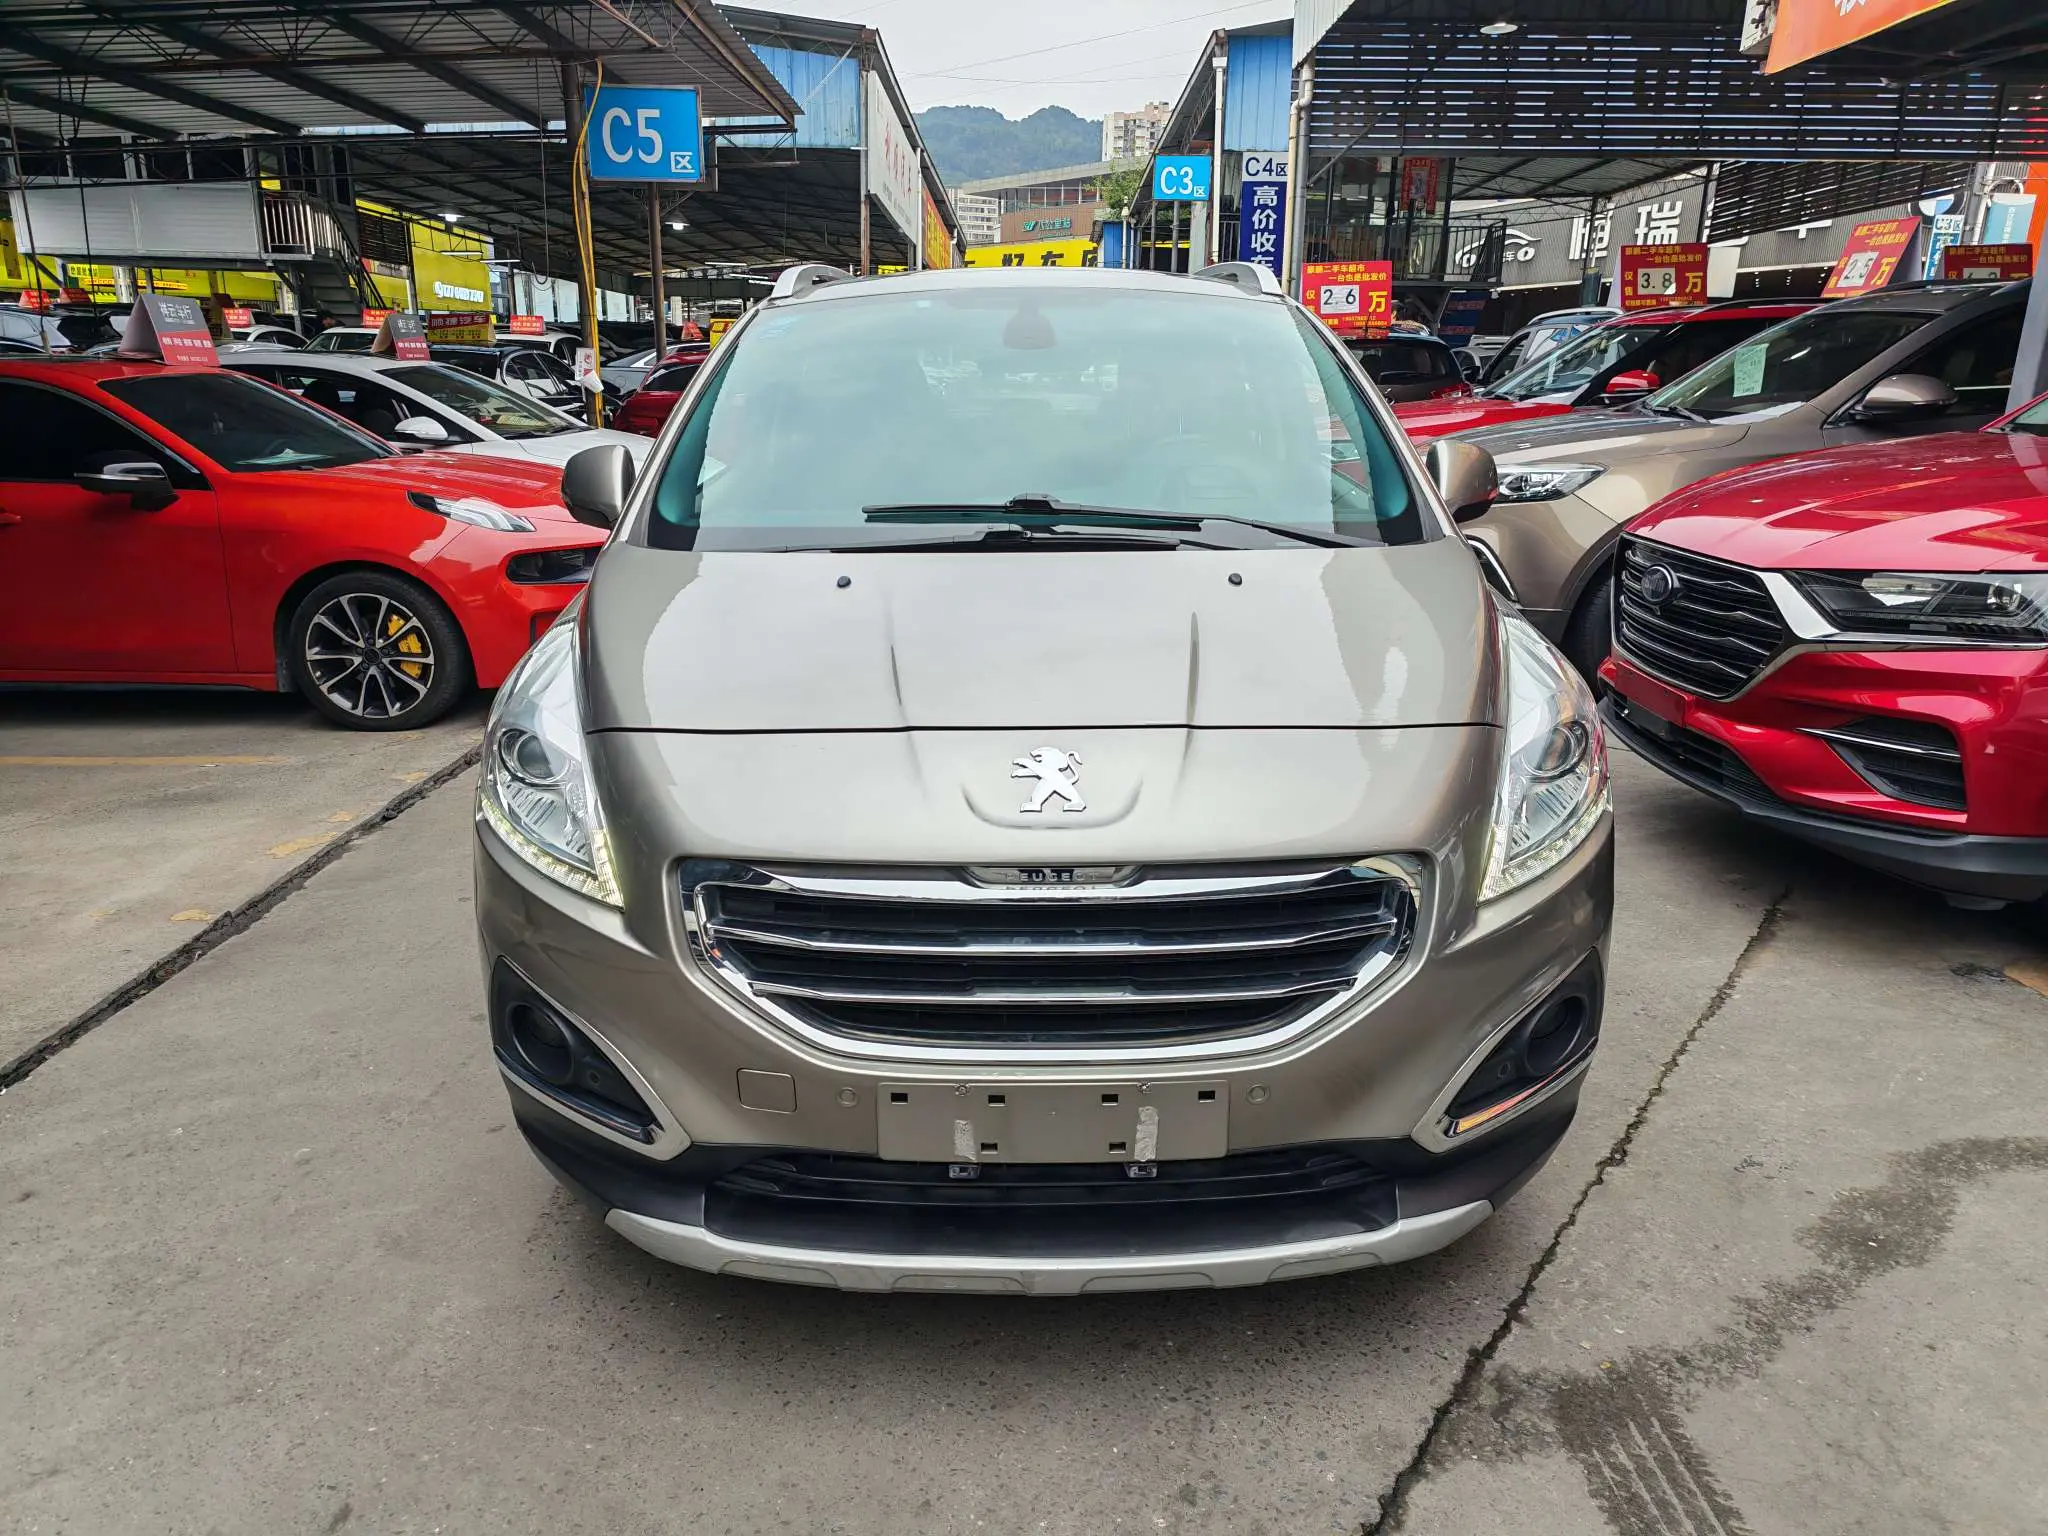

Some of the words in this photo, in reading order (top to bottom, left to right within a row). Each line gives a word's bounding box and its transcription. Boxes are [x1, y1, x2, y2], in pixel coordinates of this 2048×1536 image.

[602, 107, 695, 173] C5区
[1245, 156, 1288, 177] C4区
[1160, 166, 1207, 197] C3区
[1641, 272, 1673, 289] 3.8
[1685, 272, 1703, 293] 万
[1323, 289, 1356, 305] 2.6
[1368, 291, 1388, 313] 万
